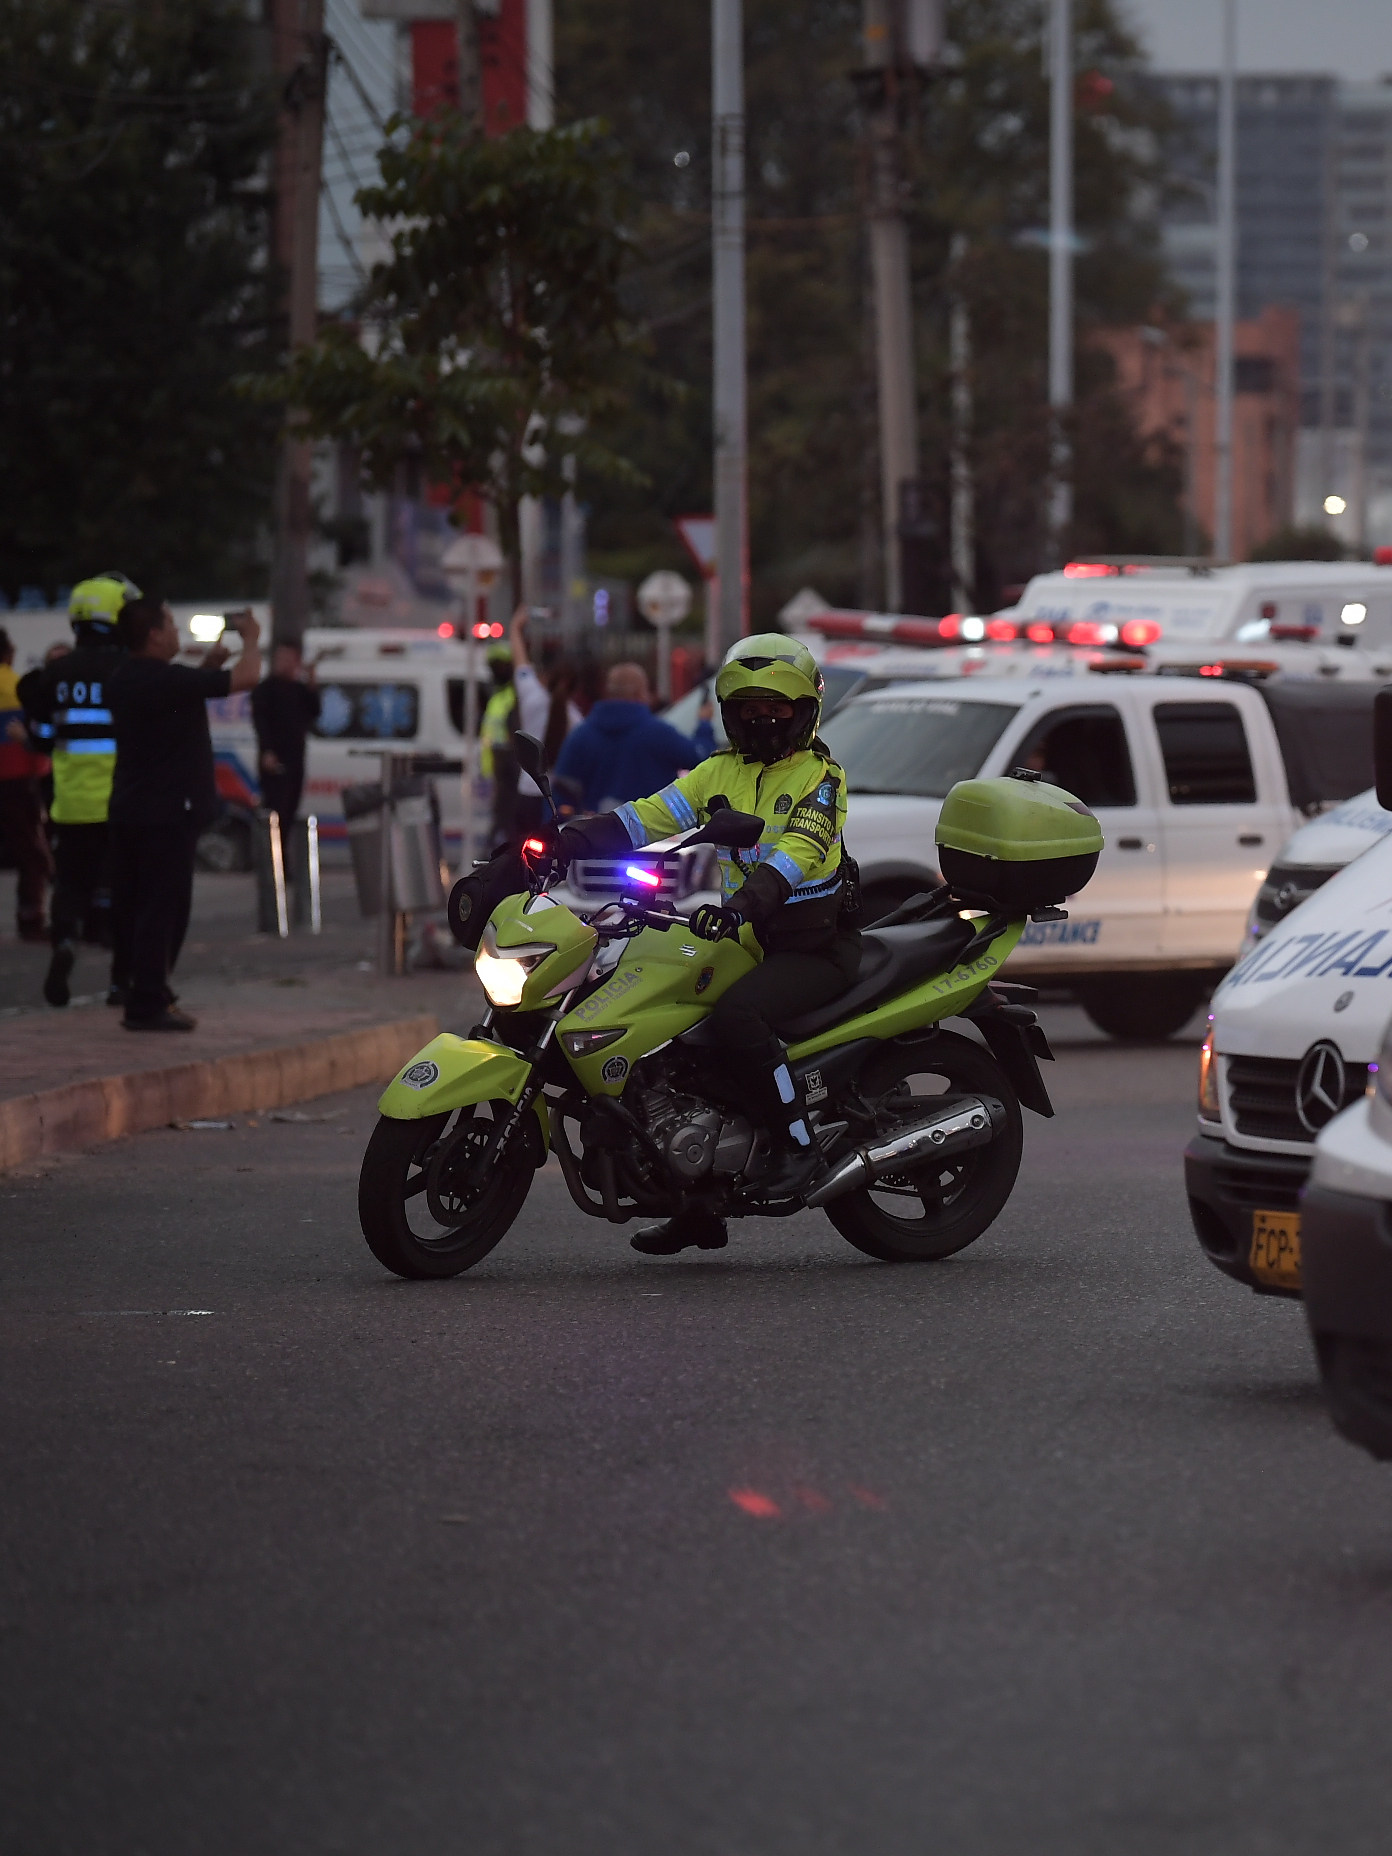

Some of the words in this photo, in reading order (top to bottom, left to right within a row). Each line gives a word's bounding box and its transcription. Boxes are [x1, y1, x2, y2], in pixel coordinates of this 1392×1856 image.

[796, 806, 832, 831] TRÁNSITO
[932, 955, 998, 994] 17-6760
[574, 971, 640, 1020] POLICIA
